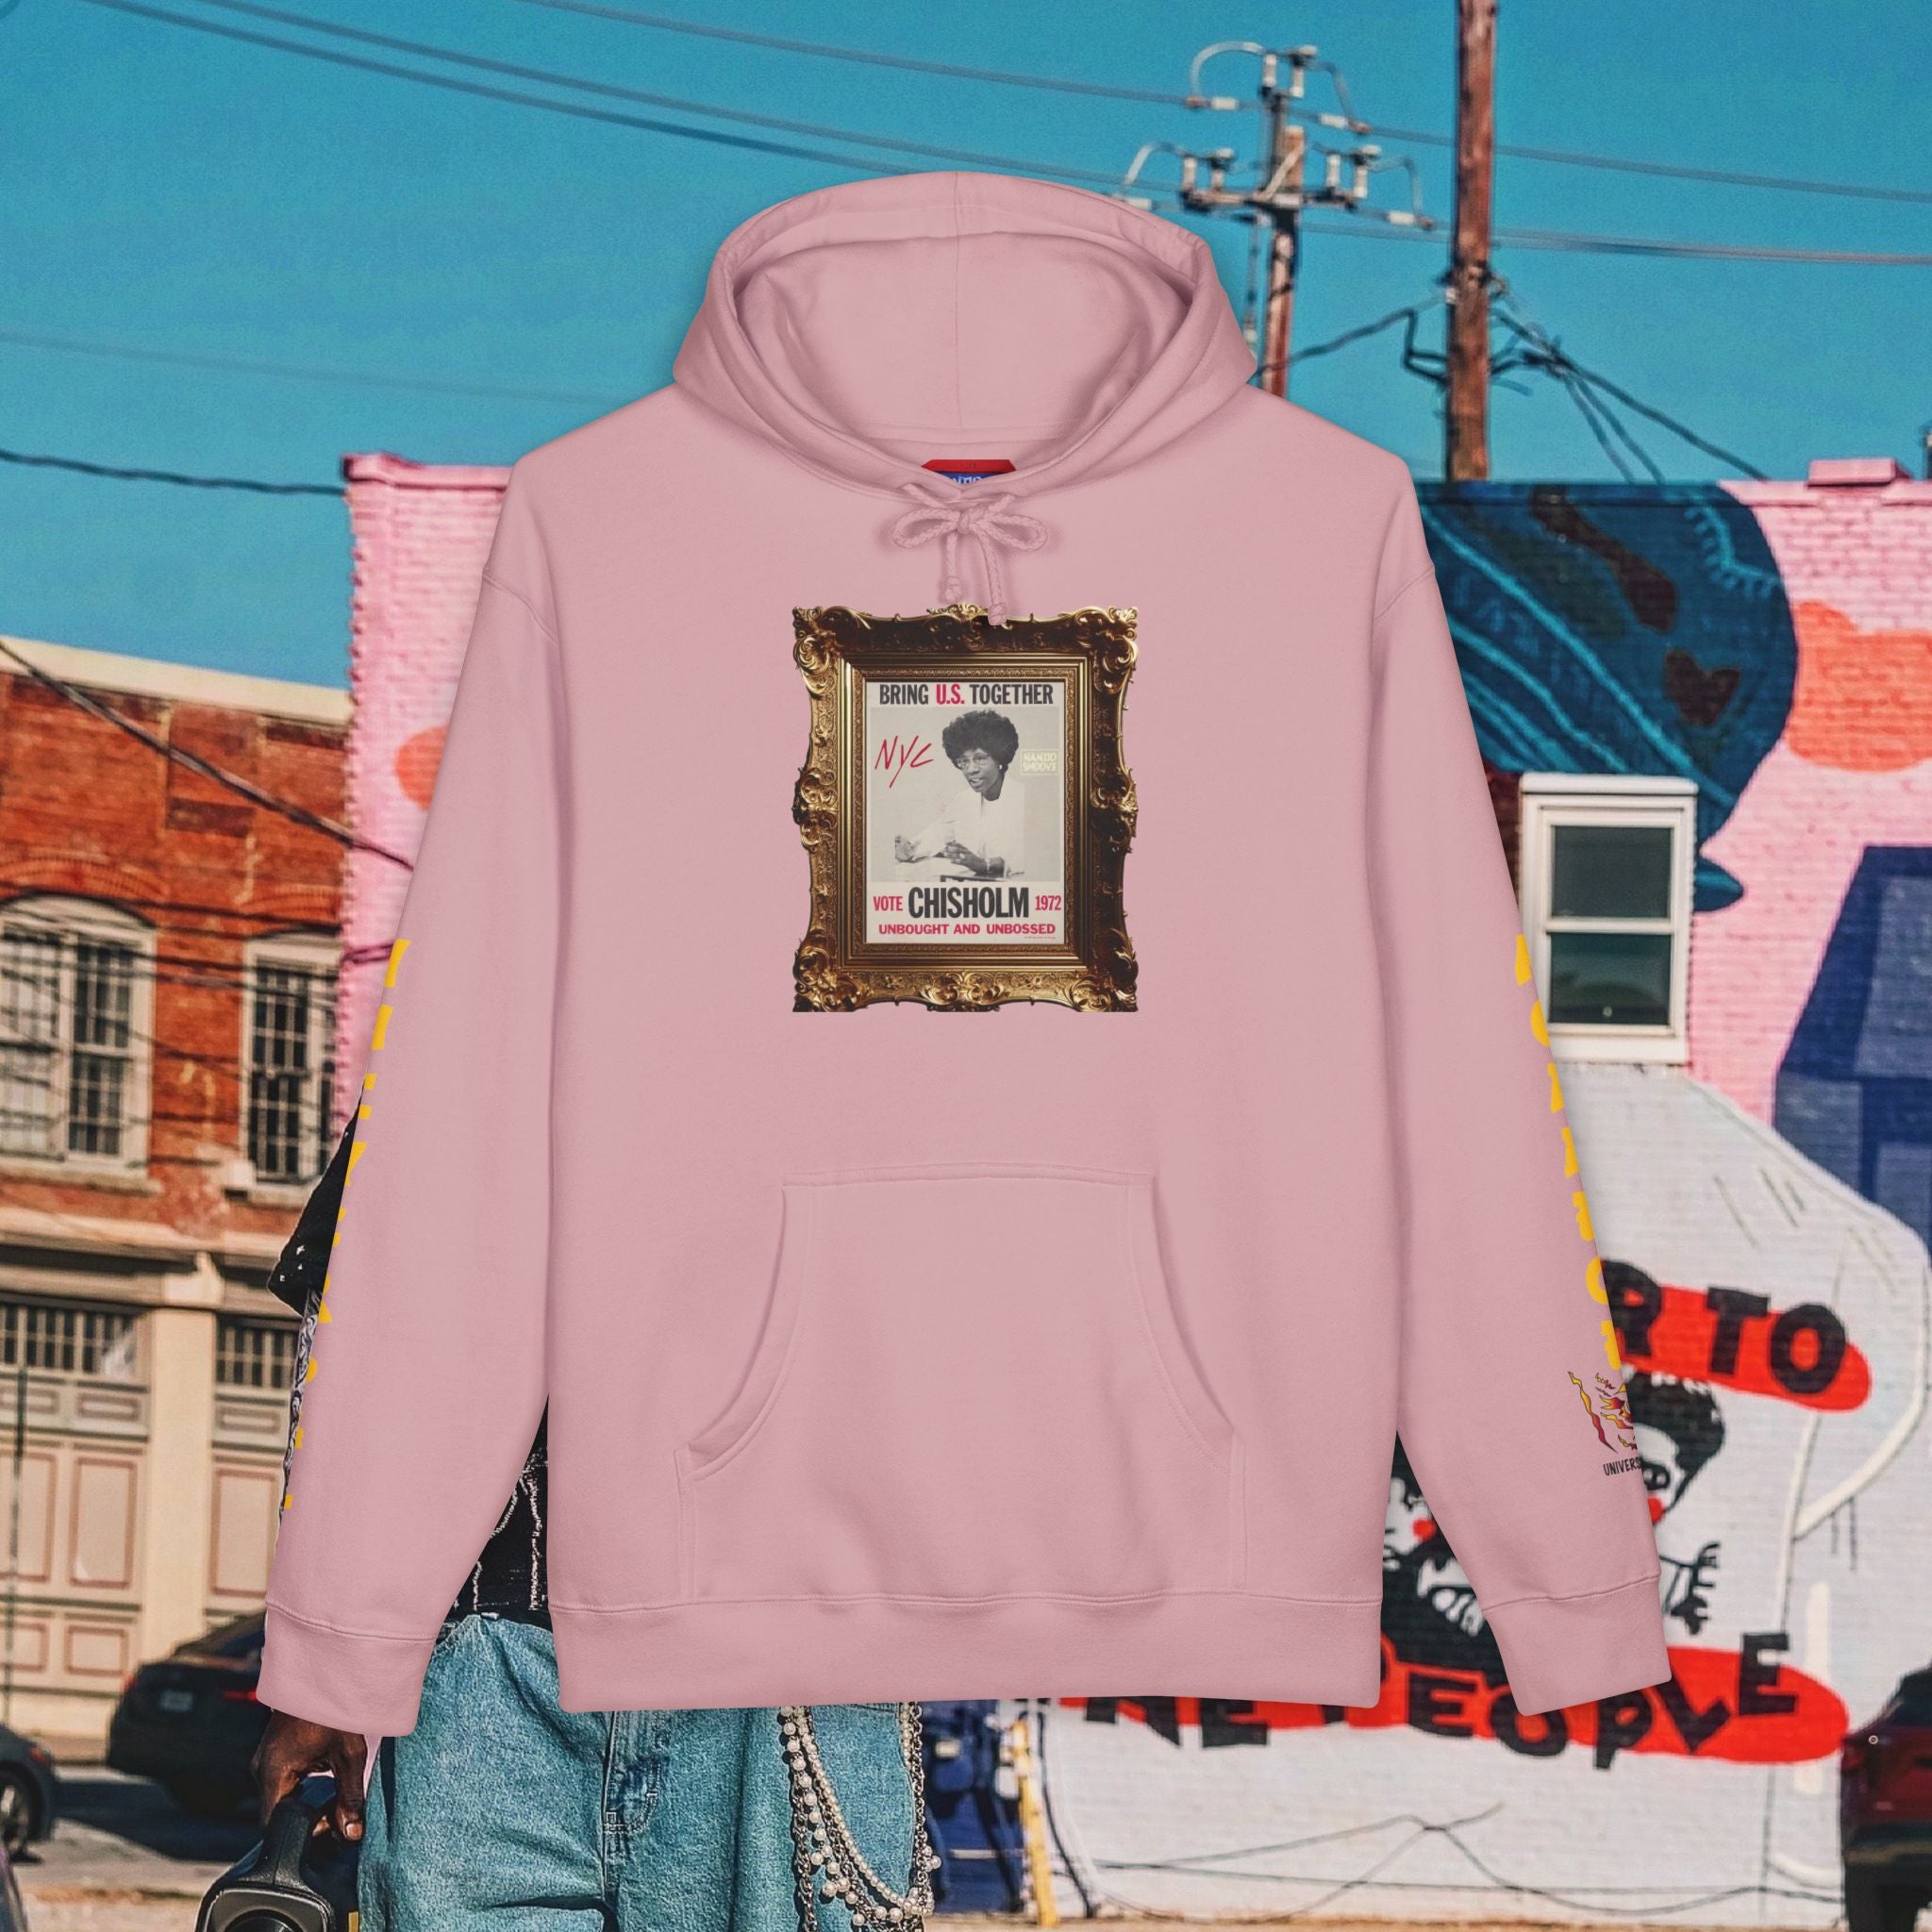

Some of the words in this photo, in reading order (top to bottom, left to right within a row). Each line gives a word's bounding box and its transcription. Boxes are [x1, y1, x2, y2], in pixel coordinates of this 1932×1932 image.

[879, 684, 929, 705] BRING
[936, 683, 965, 705] U.S.
[970, 684, 1054, 705] TOGETHER
[874, 735, 934, 788] NYC
[874, 895, 903, 911] VOTE
[908, 887, 1029, 918] CHISHOLM
[1035, 895, 1062, 911] 1972
[878, 924, 949, 934] UNBOUGHT
[954, 924, 980, 934] AND
[986, 924, 1056, 934] UNBOSSED
[1707, 1286, 1847, 1394] TO
[1321, 1633, 1798, 1771] EOPLE
